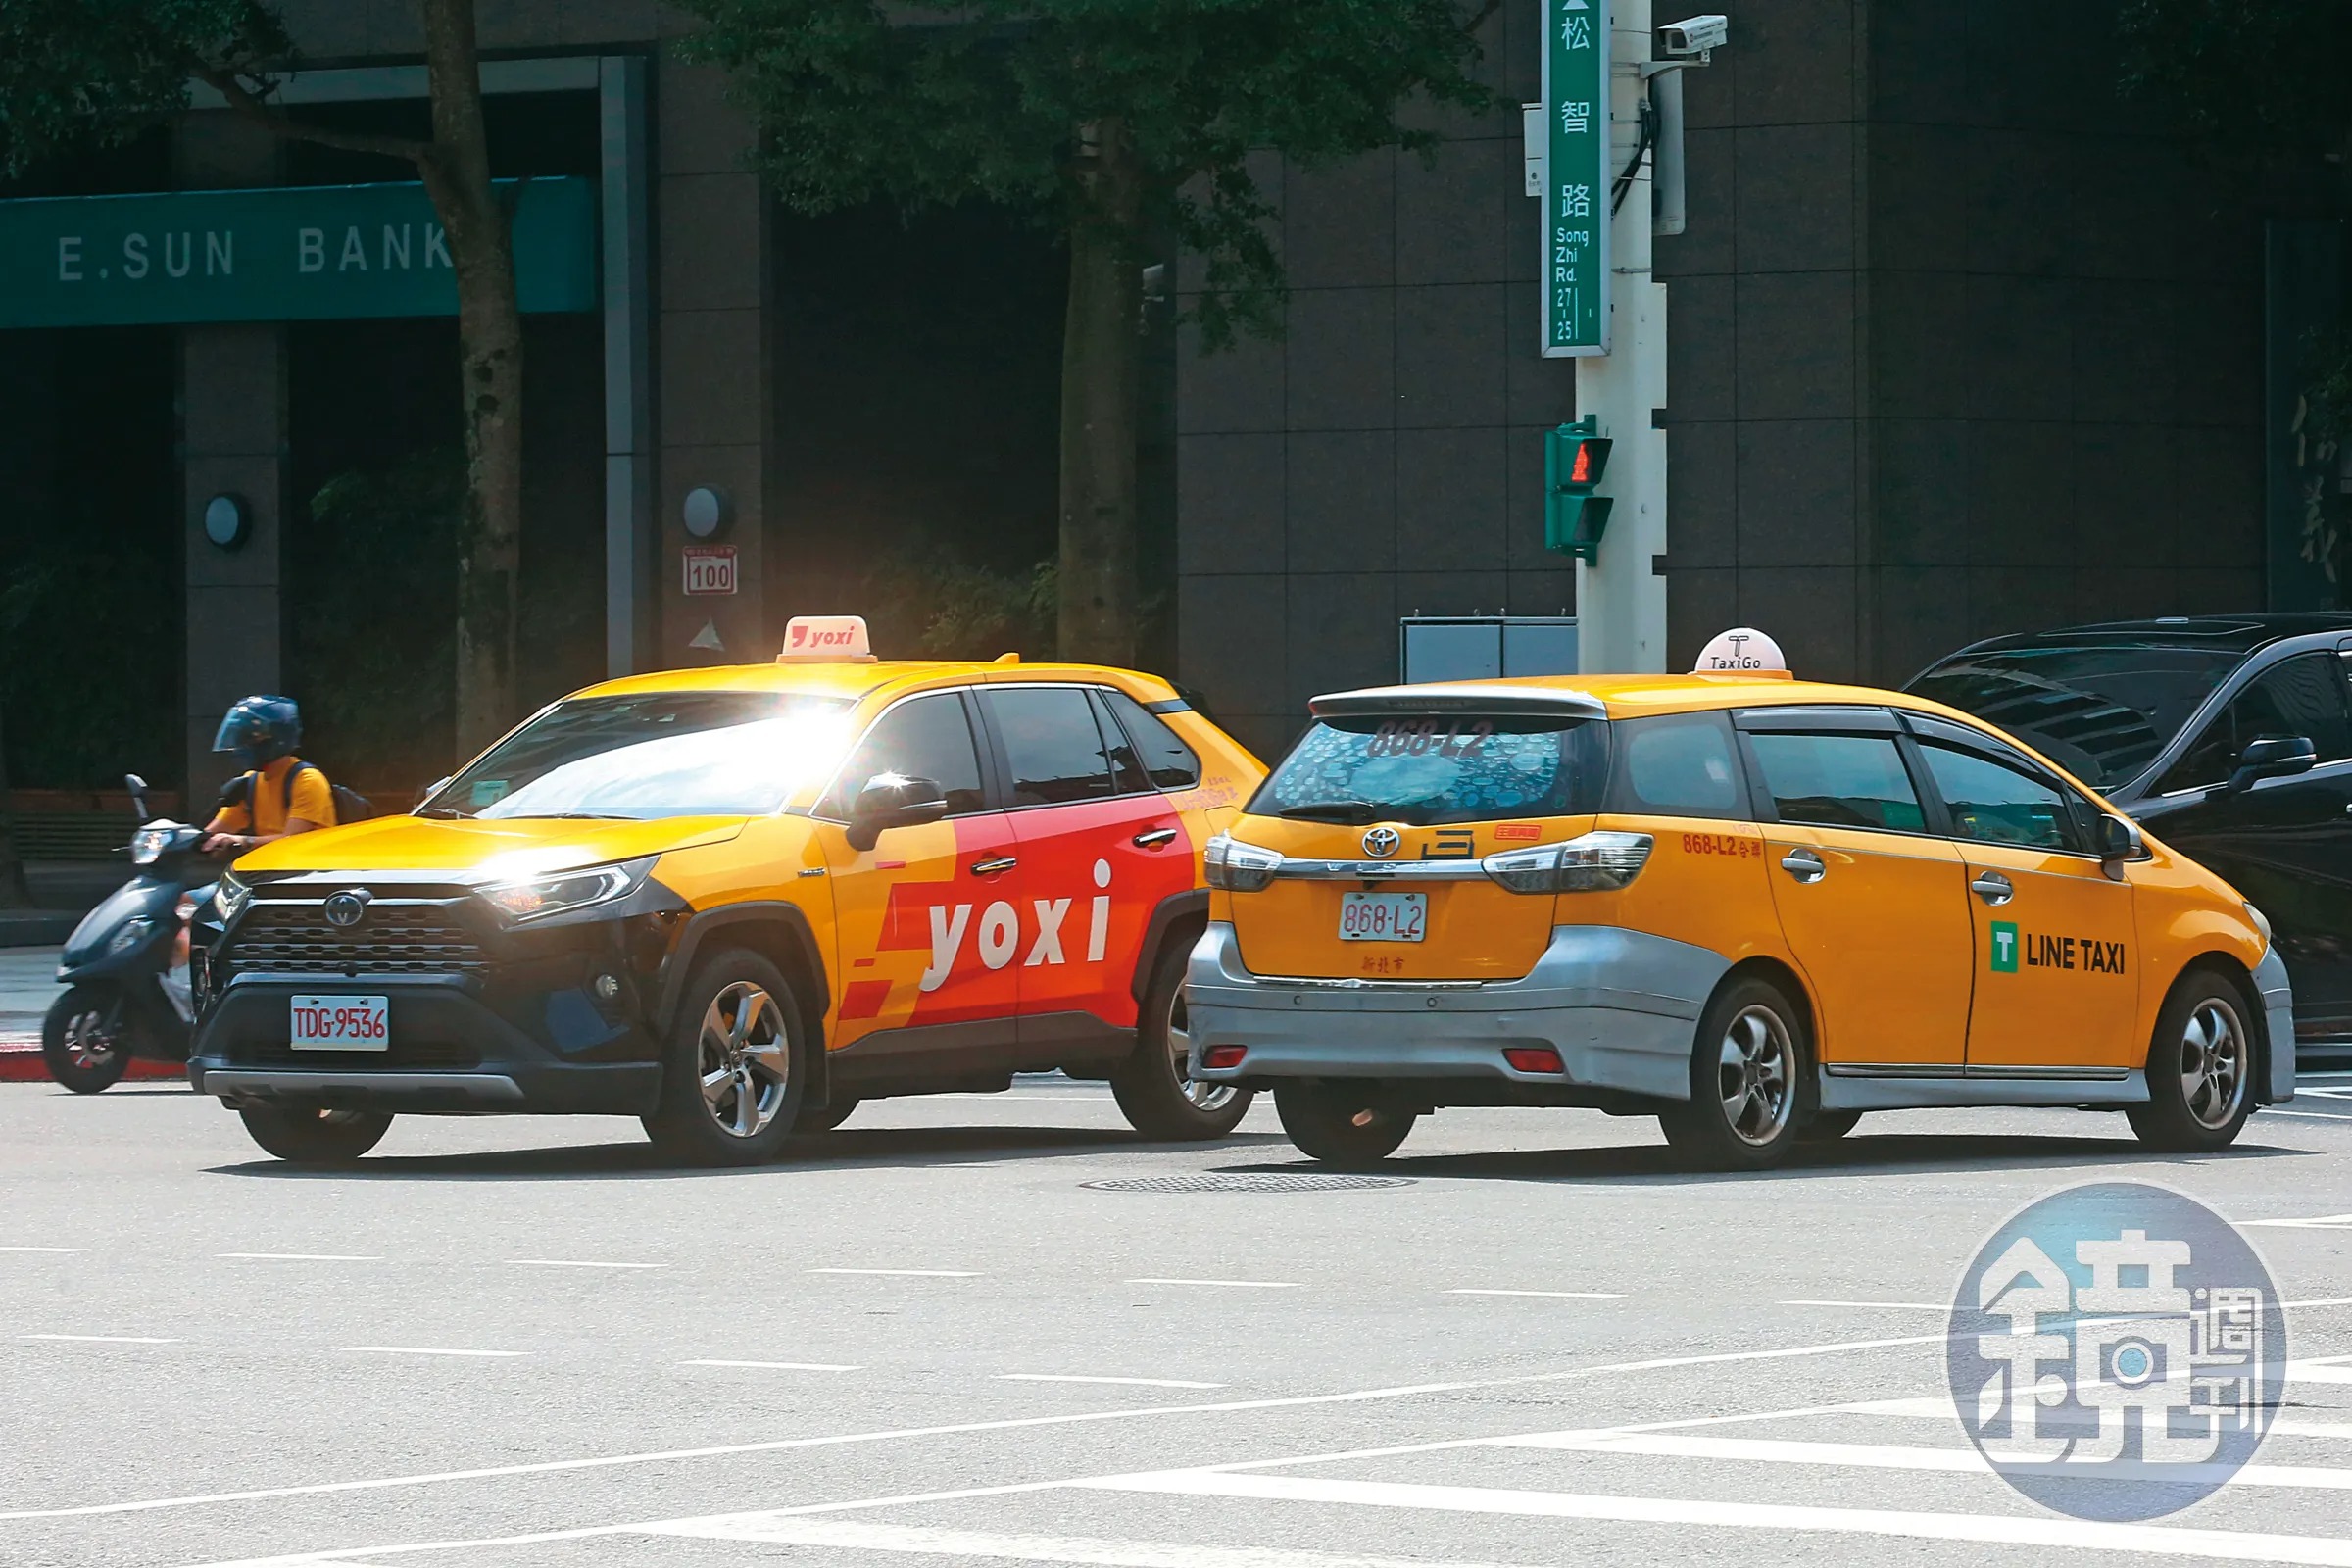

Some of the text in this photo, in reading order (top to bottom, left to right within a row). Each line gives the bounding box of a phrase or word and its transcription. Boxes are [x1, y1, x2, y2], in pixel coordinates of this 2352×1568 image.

[1561, 16, 1591, 218] 松智路
[1555, 226, 1589, 247] Song
[58, 221, 456, 281] E.SUN BANK
[1555, 247, 1578, 263] Zhi
[1555, 267, 1577, 282] Rd.
[1557, 287, 1572, 307] 27
[1557, 321, 1572, 340] 25
[692, 564, 730, 588] 100
[809, 625, 856, 649] yoxi
[1710, 656, 1761, 669] TaxiGo
[1367, 717, 1494, 758] 868-L2
[1682, 833, 1738, 856] 868-L2
[917, 857, 1112, 993] yoxi
[2027, 933, 2075, 970] LINE
[2080, 938, 2125, 975] TAXI
